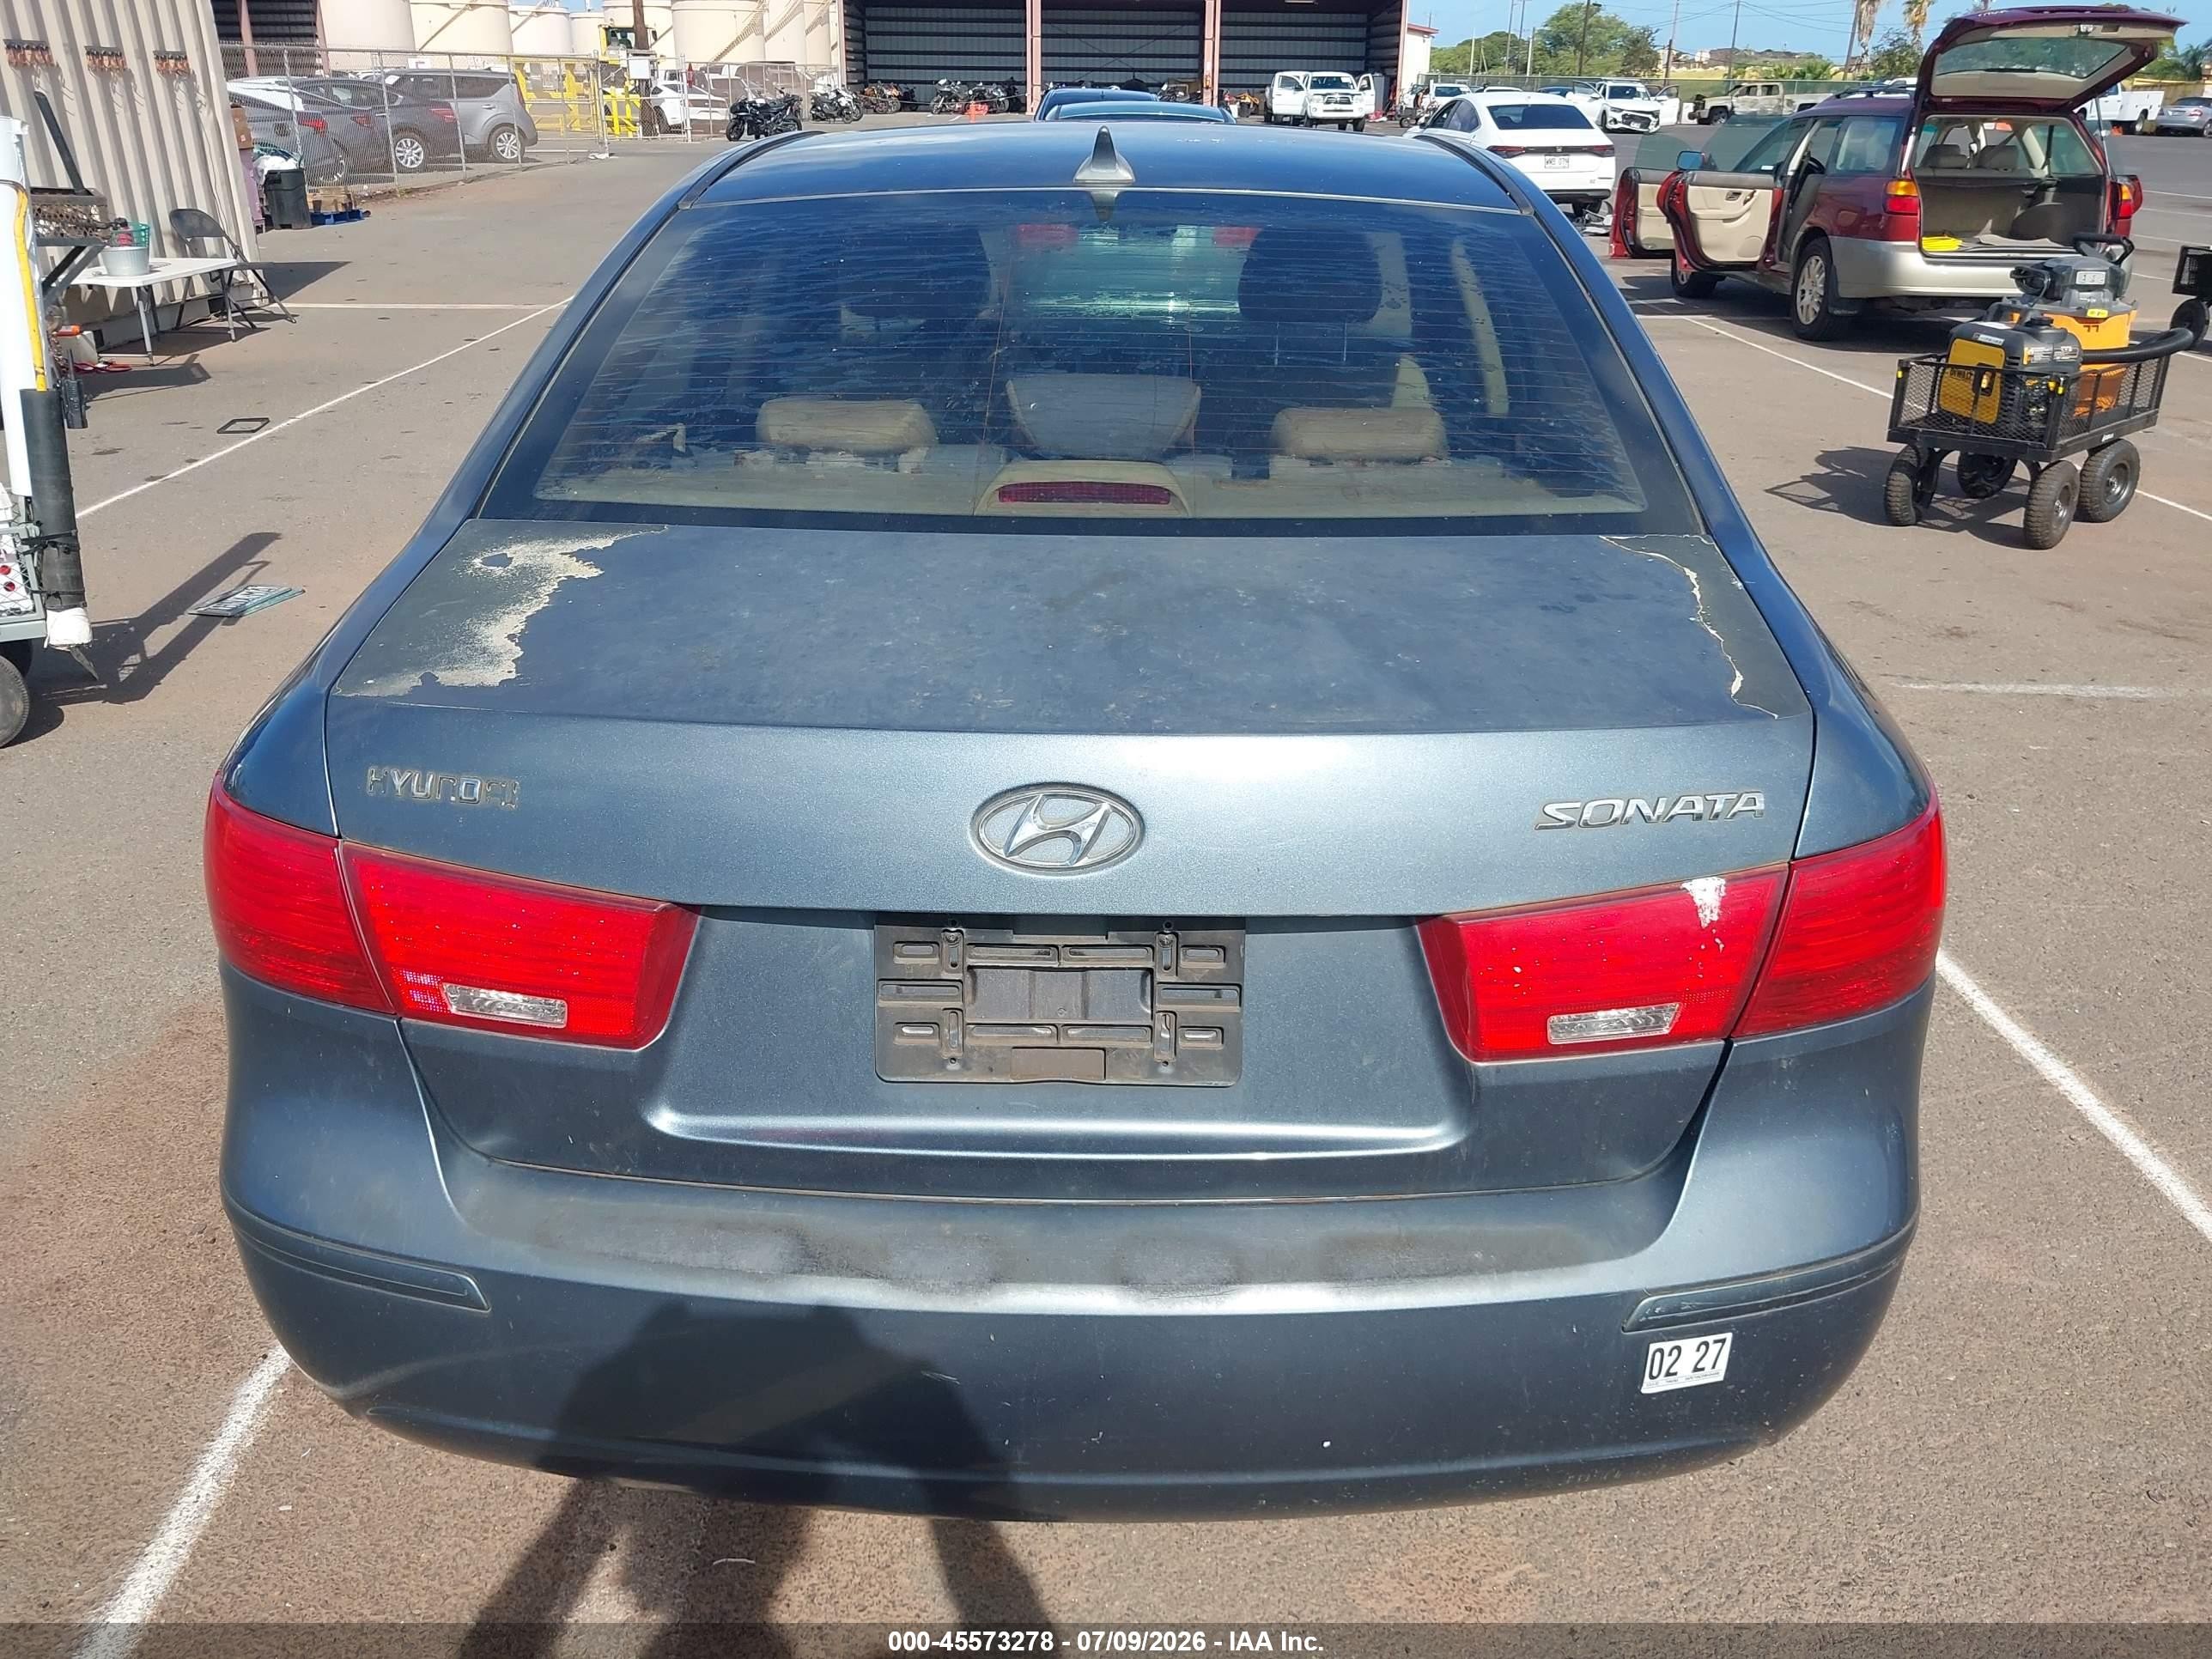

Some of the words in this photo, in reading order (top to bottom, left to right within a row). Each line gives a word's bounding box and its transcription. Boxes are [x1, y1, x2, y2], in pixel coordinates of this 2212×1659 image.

[1534, 790, 1765, 830] SONATA
[1649, 1345, 1682, 1380] 02
[1692, 1337, 1727, 1373] 27
